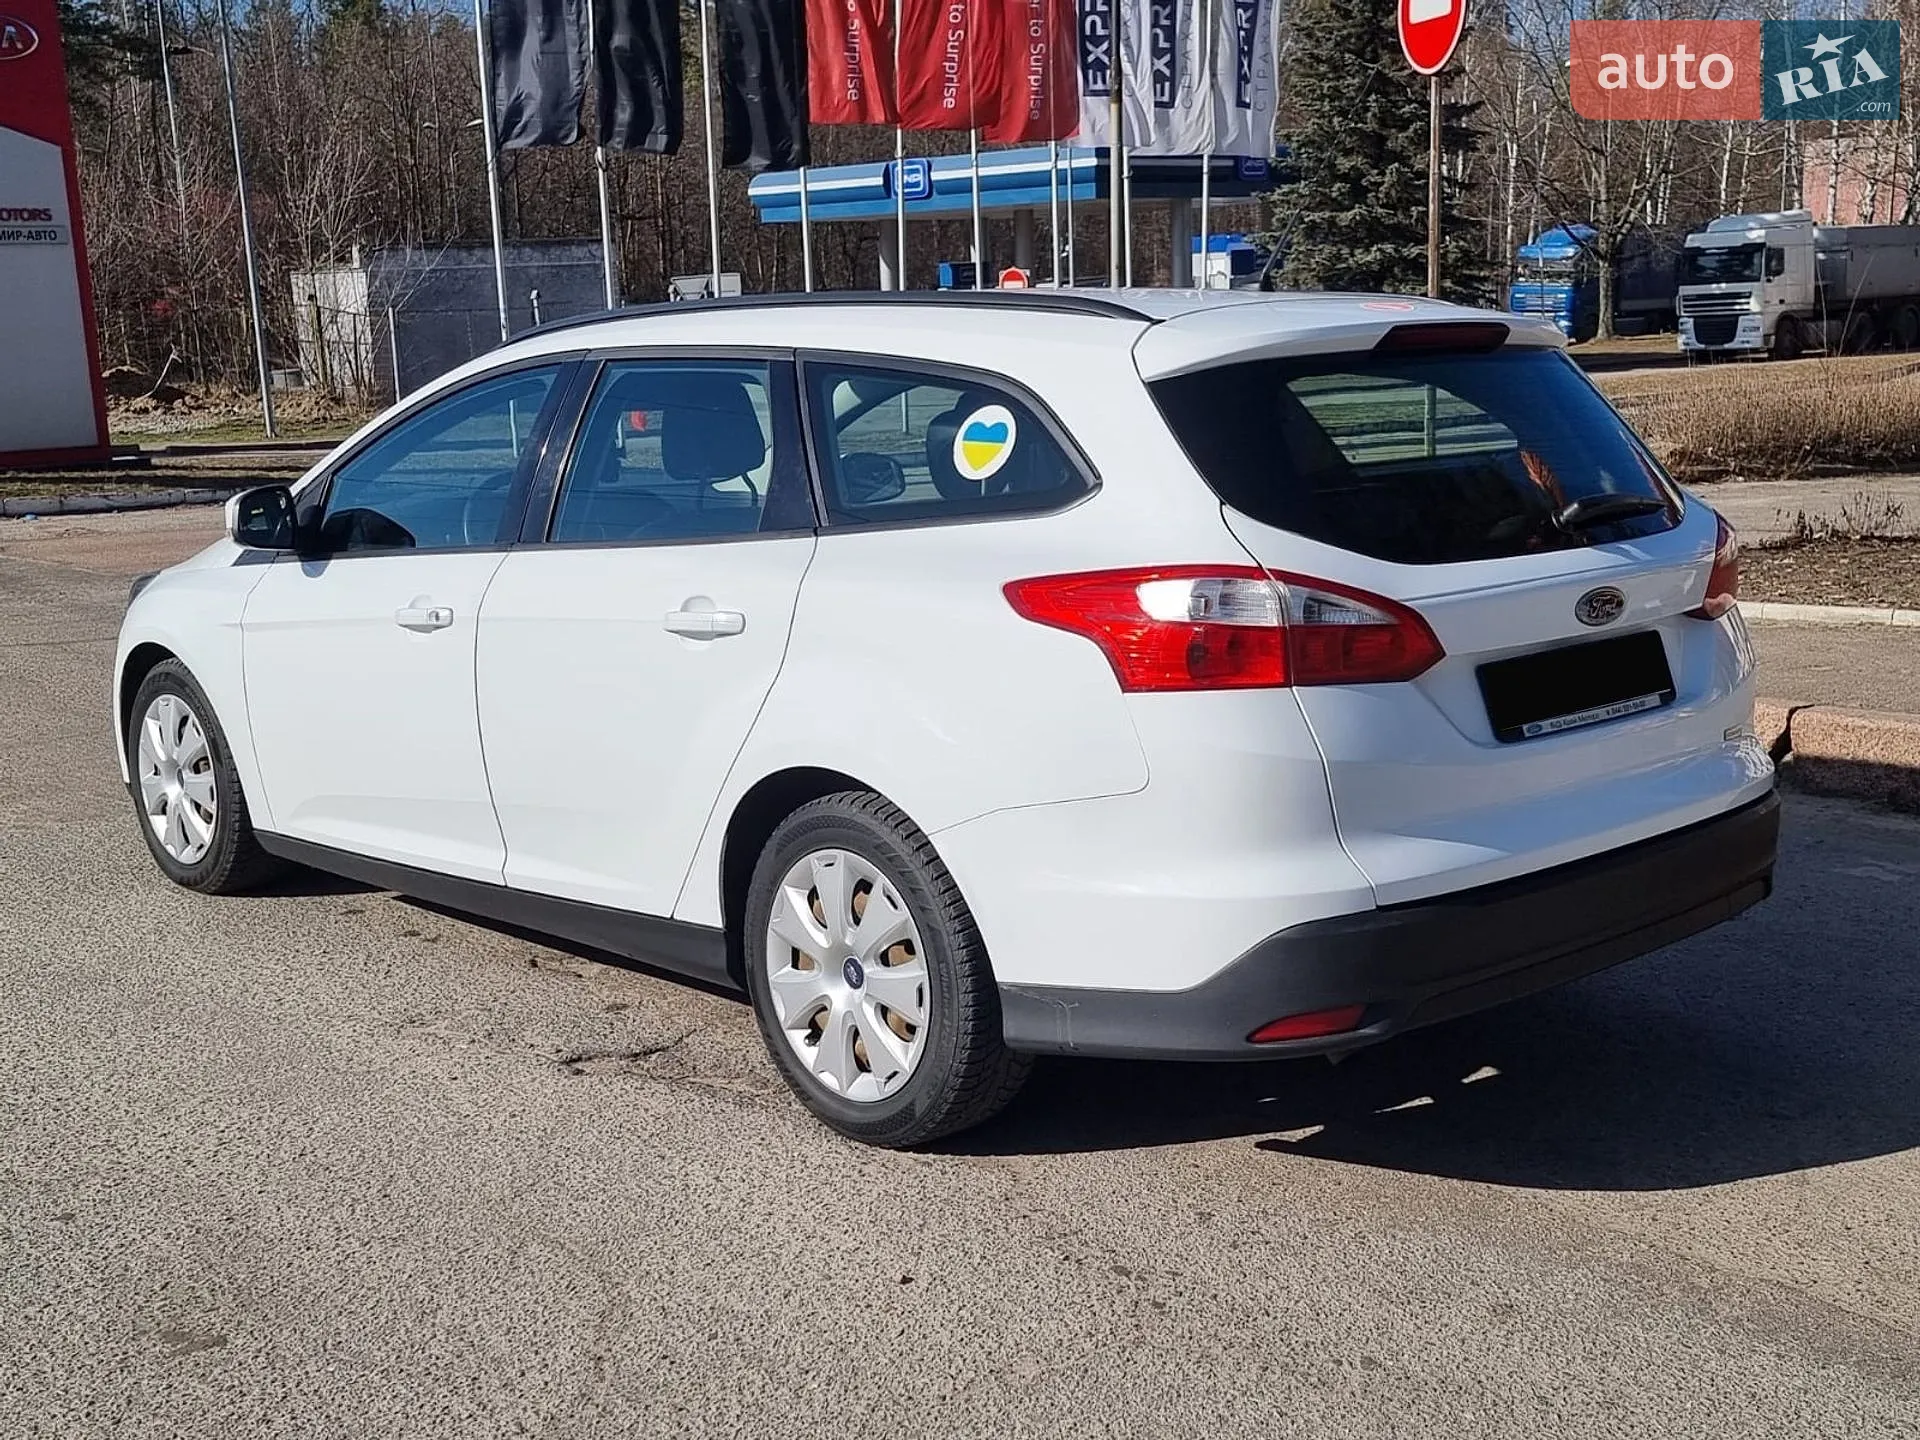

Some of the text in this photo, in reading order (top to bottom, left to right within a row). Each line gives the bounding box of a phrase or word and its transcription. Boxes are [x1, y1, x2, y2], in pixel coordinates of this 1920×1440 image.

[844, 19, 861, 101] Surprise
[941, 1, 967, 110] to Surprise
[1029, 19, 1045, 37] to
[1026, 43, 1046, 121] Surprise
